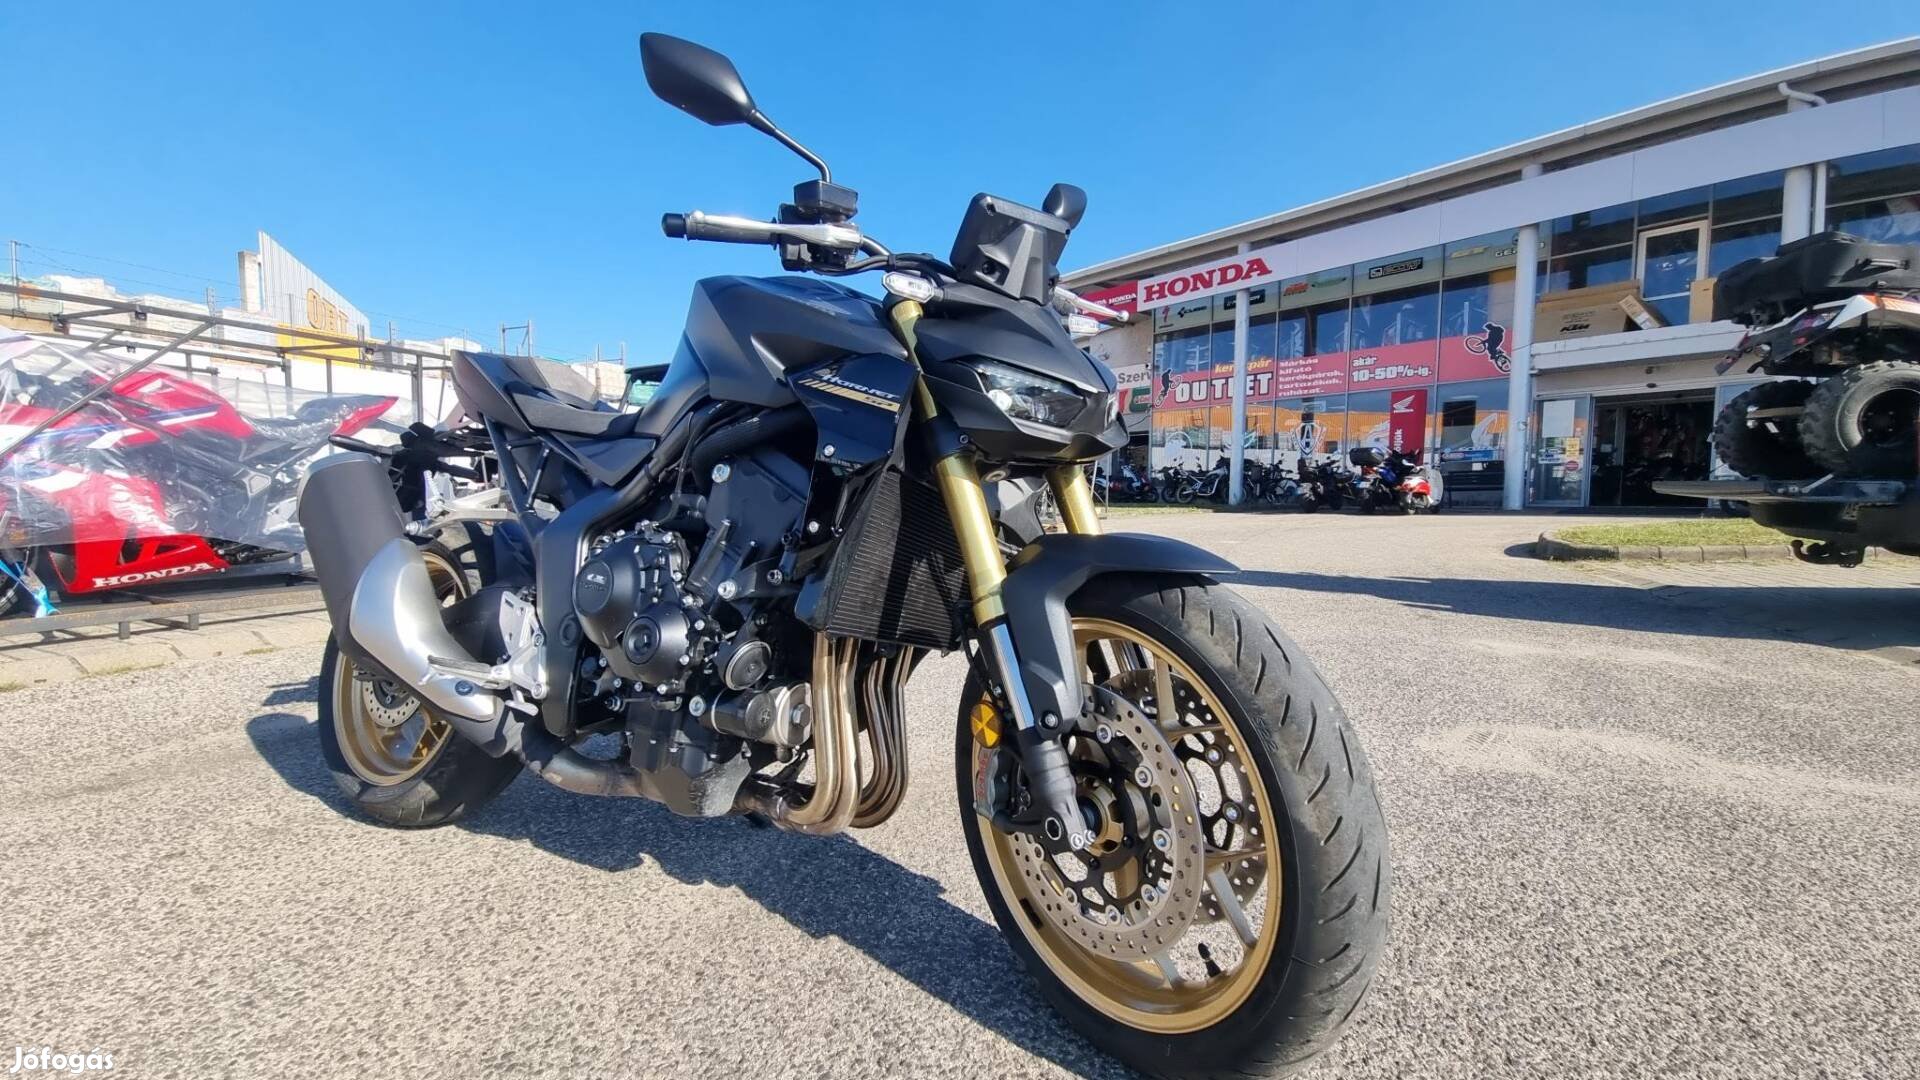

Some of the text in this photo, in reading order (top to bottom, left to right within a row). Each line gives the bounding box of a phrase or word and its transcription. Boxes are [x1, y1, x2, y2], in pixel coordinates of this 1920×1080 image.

[1144, 257, 1272, 303] HONDA
[1108, 293, 1137, 305] HONDA
[307, 288, 349, 333] OBI
[1215, 357, 1272, 373] kerpár
[1352, 356, 1377, 367] akár
[92, 562, 214, 588] HONDA
